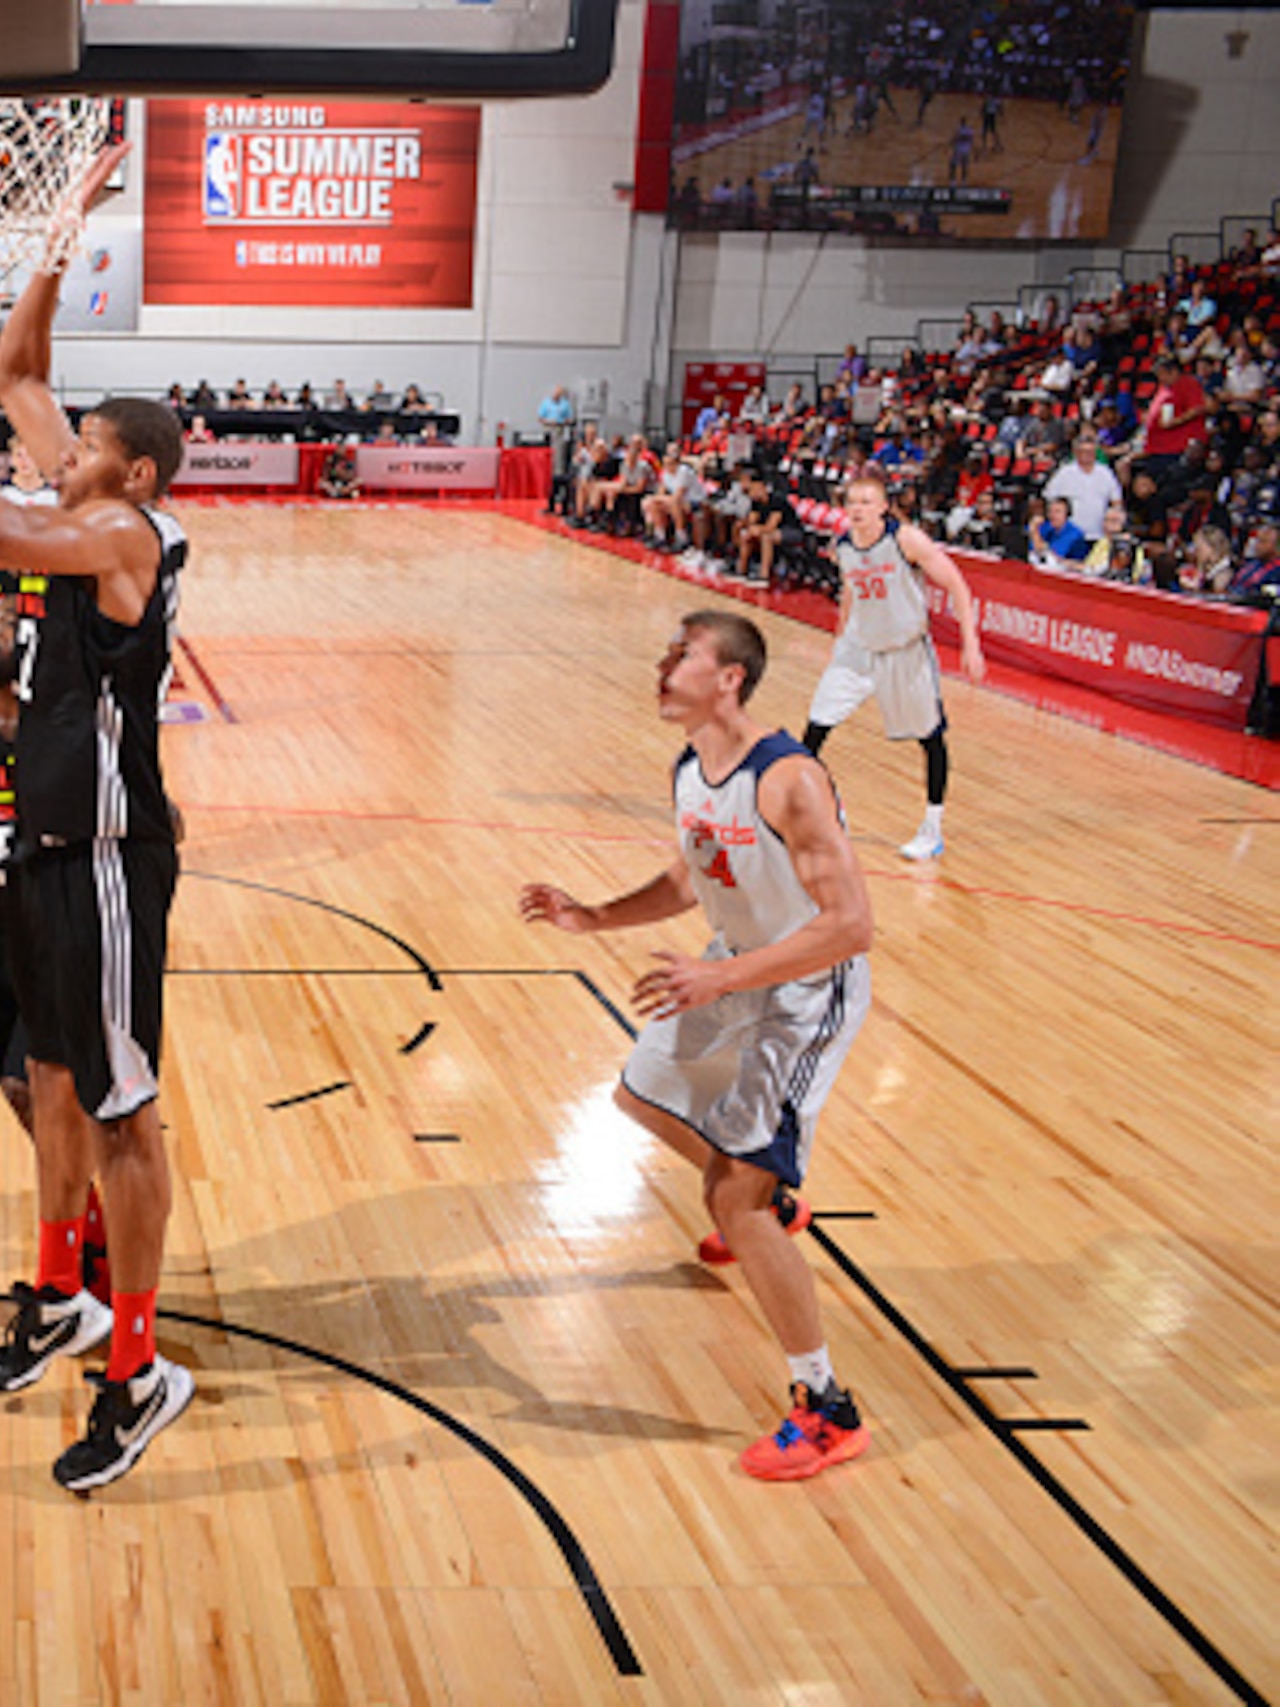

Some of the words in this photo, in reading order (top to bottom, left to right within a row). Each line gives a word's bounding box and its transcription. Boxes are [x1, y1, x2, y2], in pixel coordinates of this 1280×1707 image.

[205, 104, 325, 127] SAMSUNG
[246, 136, 420, 178] SUMMER
[246, 180, 392, 218] LEAGUE
[1050, 618, 1117, 666] LEAGUE
[699, 849, 737, 888] 4
